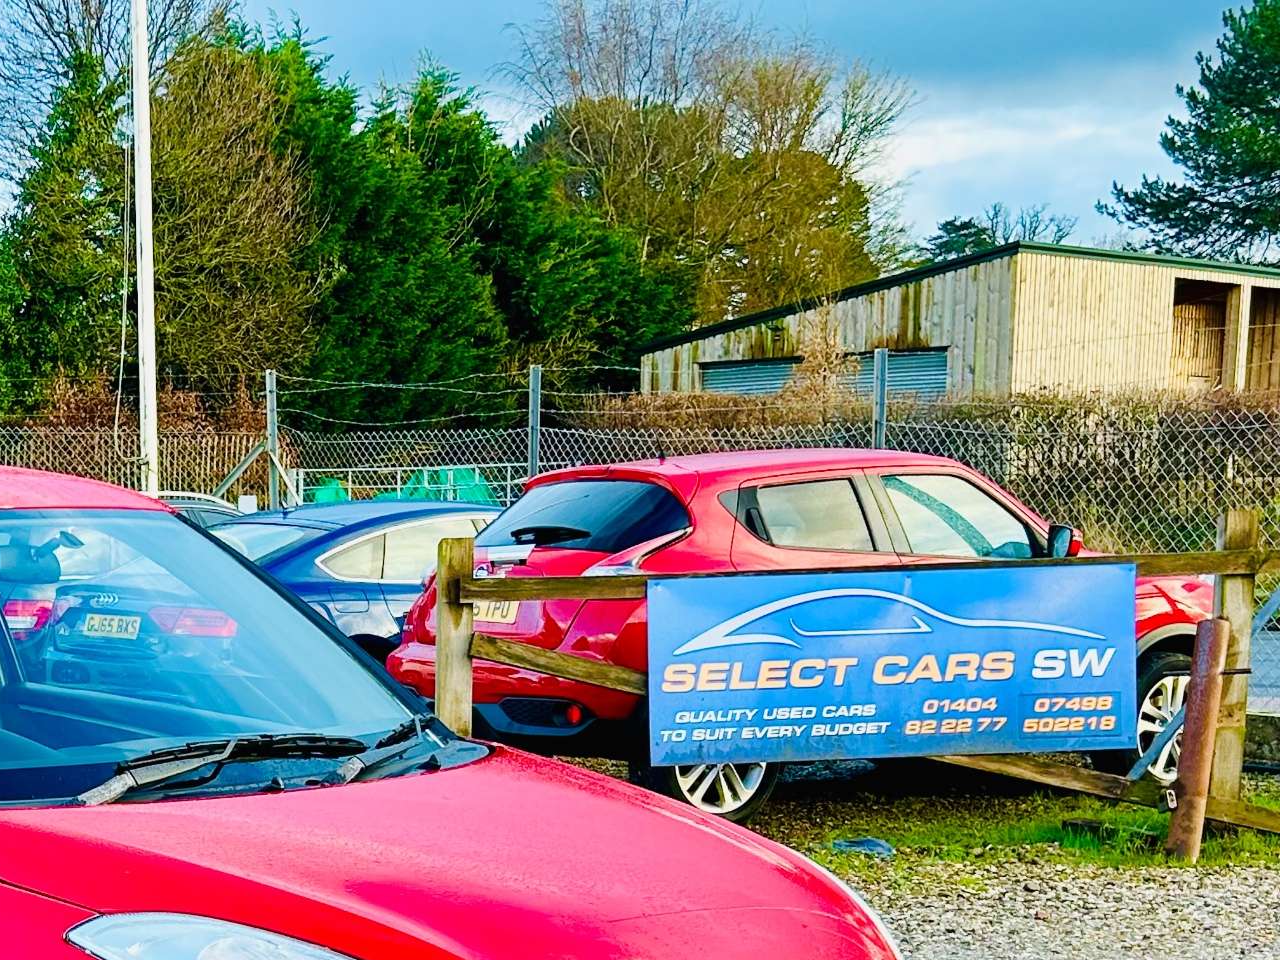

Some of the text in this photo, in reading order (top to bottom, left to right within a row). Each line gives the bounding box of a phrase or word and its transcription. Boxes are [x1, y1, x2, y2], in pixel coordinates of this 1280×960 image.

[661, 647, 1116, 693] SELECT CARS SW
[922, 697, 998, 714] 01404
[1034, 696, 1112, 713] 07498
[675, 704, 876, 724] QUALITY USED CARS
[660, 721, 891, 742] TO SUIT EVERY BUDGET
[904, 717, 1007, 735] 82 22 77
[1022, 716, 1116, 733] 502218
